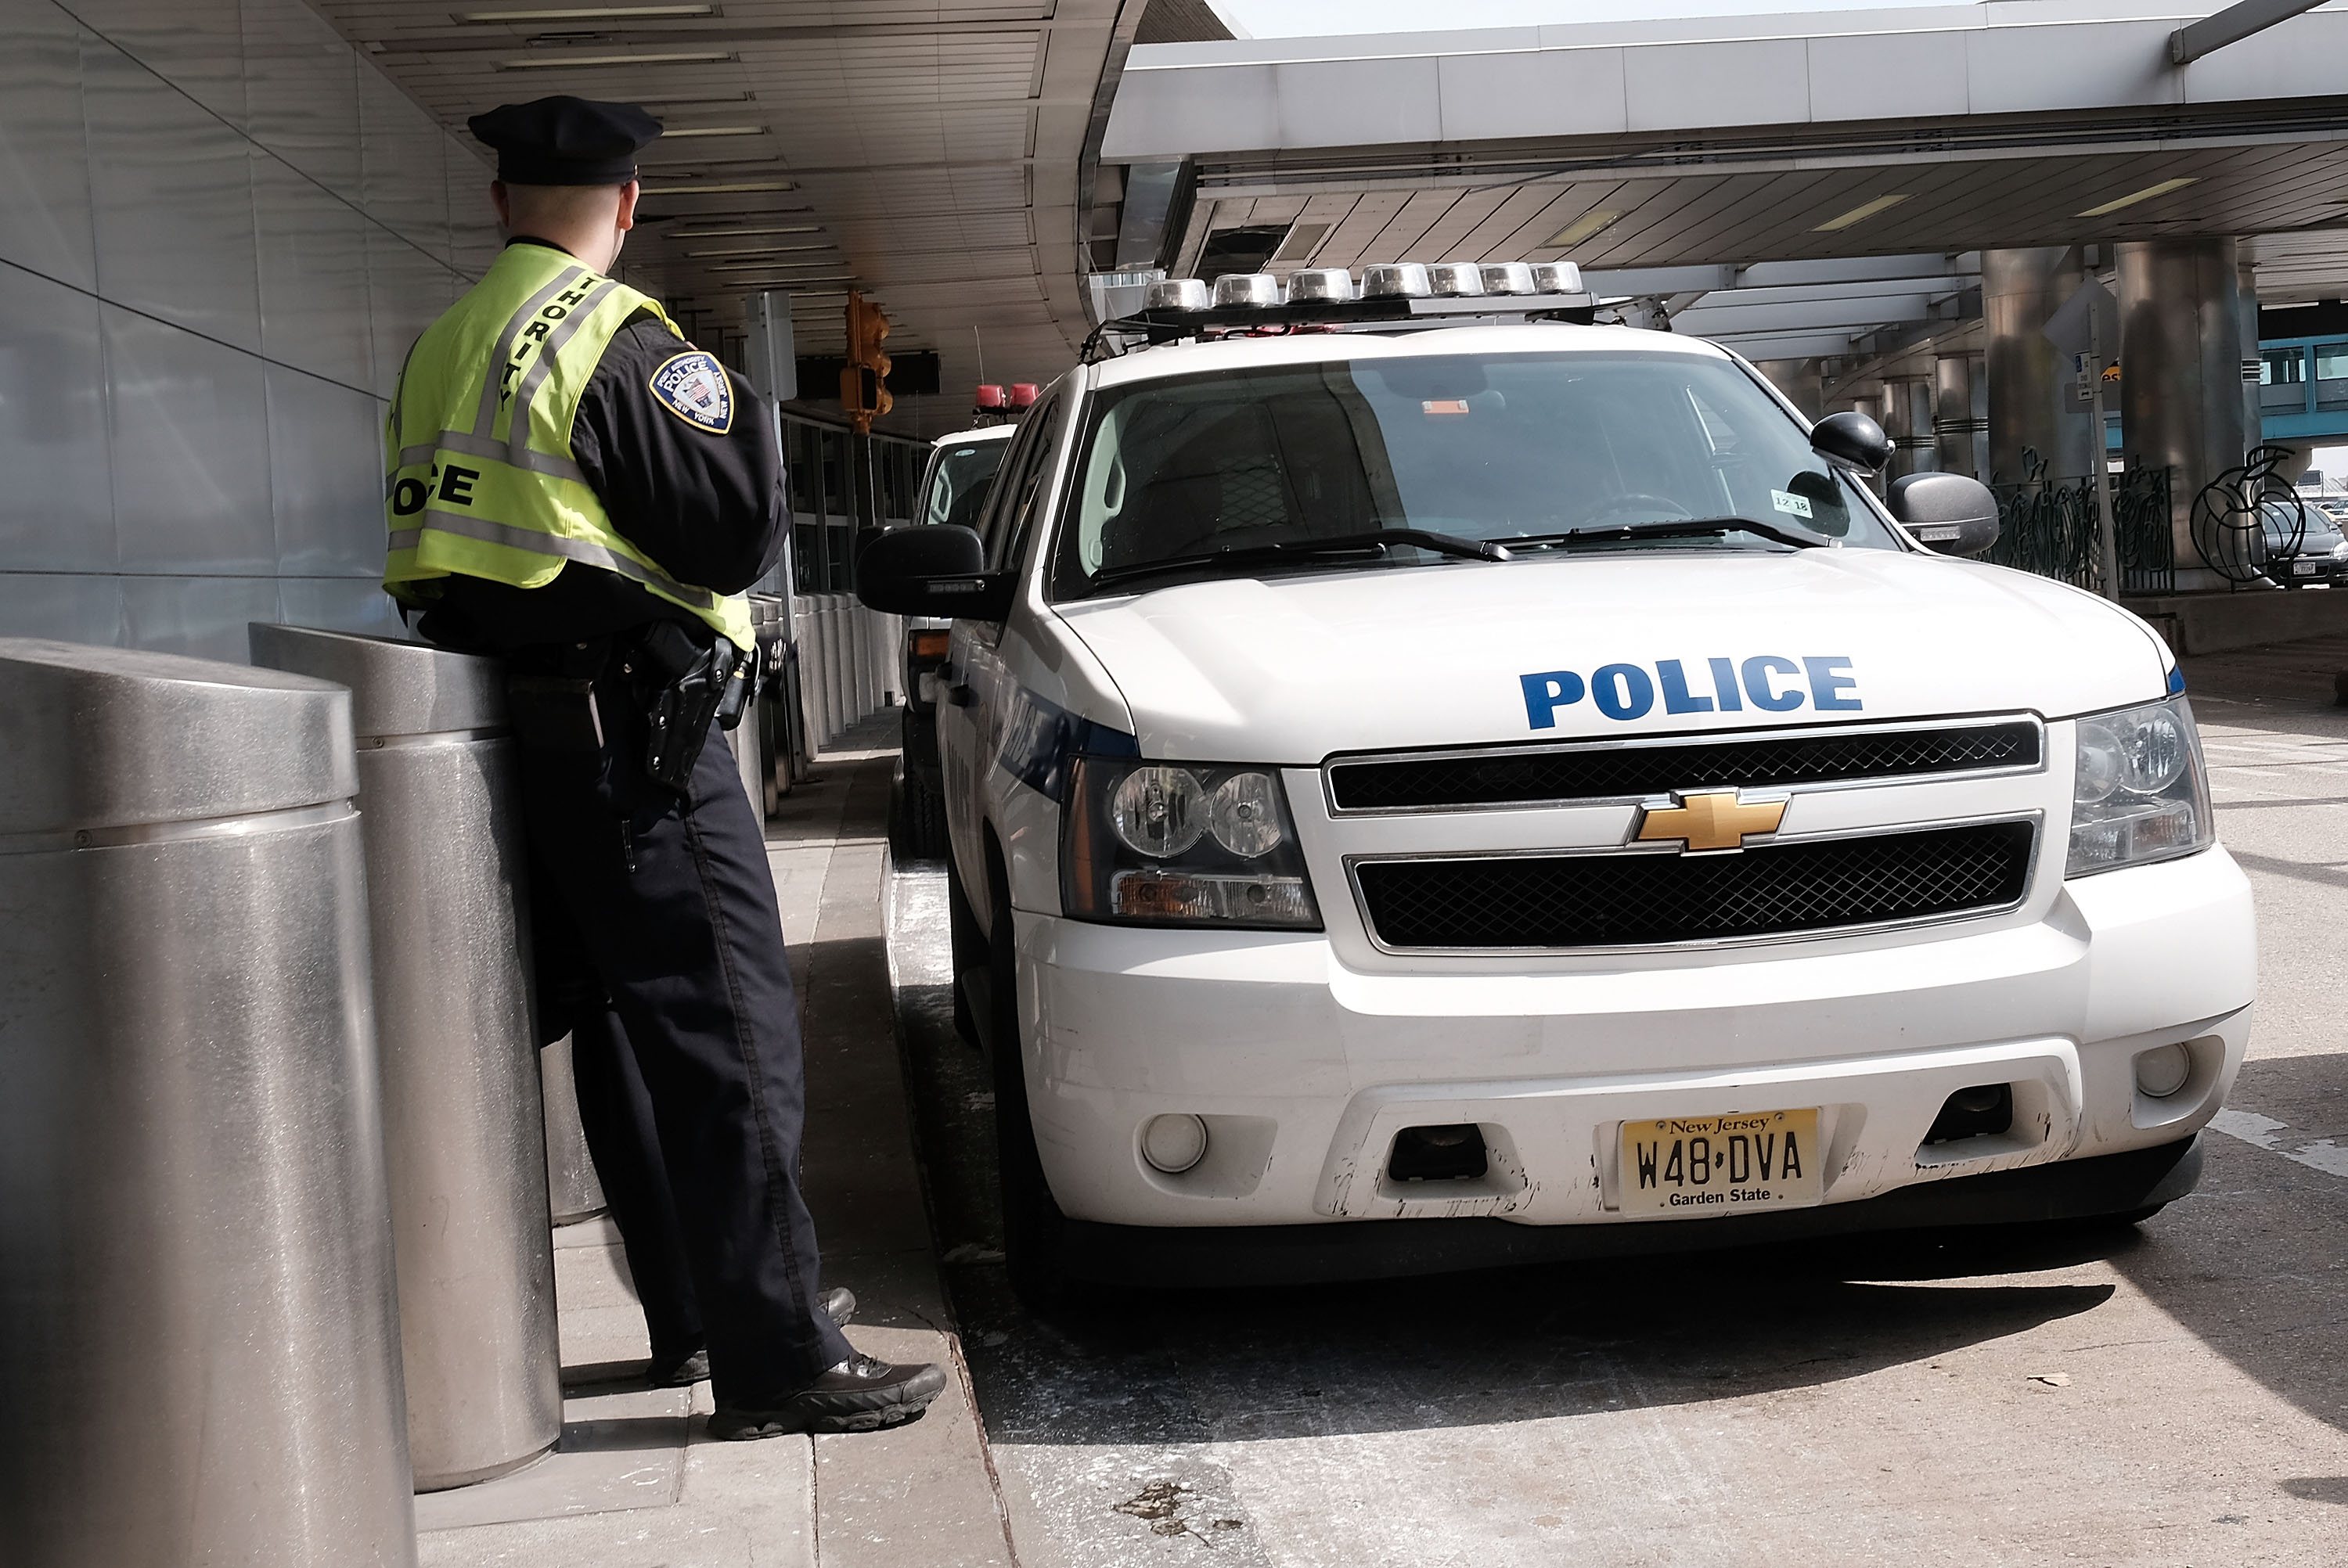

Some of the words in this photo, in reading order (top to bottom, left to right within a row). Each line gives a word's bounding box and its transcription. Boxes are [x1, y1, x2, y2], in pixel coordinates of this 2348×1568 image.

[499, 275, 600, 412] THORITY
[663, 361, 709, 393] POLICE
[672, 399, 690, 414] NEW
[694, 412, 715, 426] YORK
[1776, 498, 1790, 507] 12
[1520, 656, 1864, 730] POLICE
[1669, 1120, 1712, 1135] New
[1713, 1117, 1770, 1135] Jersey
[1669, 1191, 1724, 1207] Garden
[1730, 1188, 1771, 1203] State
